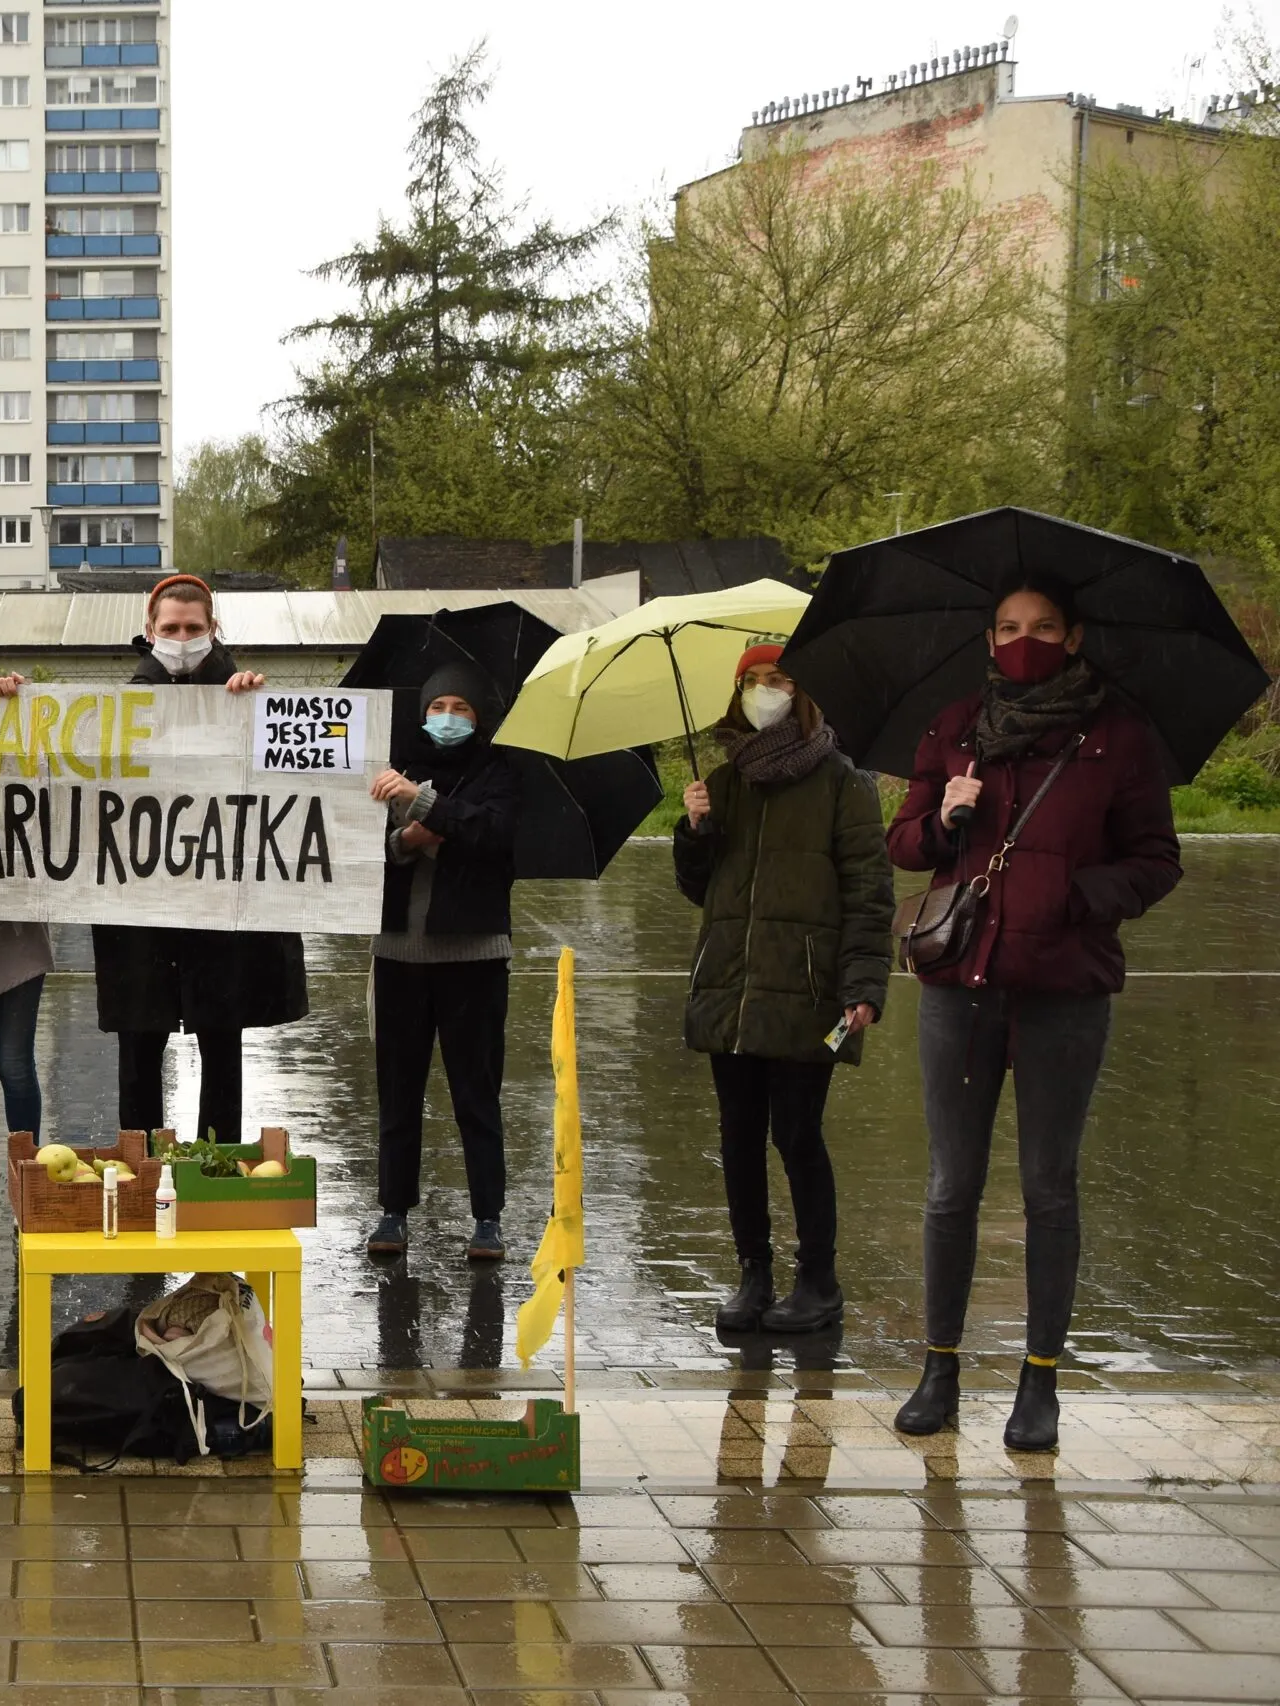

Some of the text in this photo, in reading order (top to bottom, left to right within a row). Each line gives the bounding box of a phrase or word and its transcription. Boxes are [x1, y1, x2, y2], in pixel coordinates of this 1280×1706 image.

[266, 696, 353, 720] MIASTO
[265, 721, 318, 745] JEST
[264, 746, 336, 769] NASZE
[96, 793, 333, 885] ROGATKA
